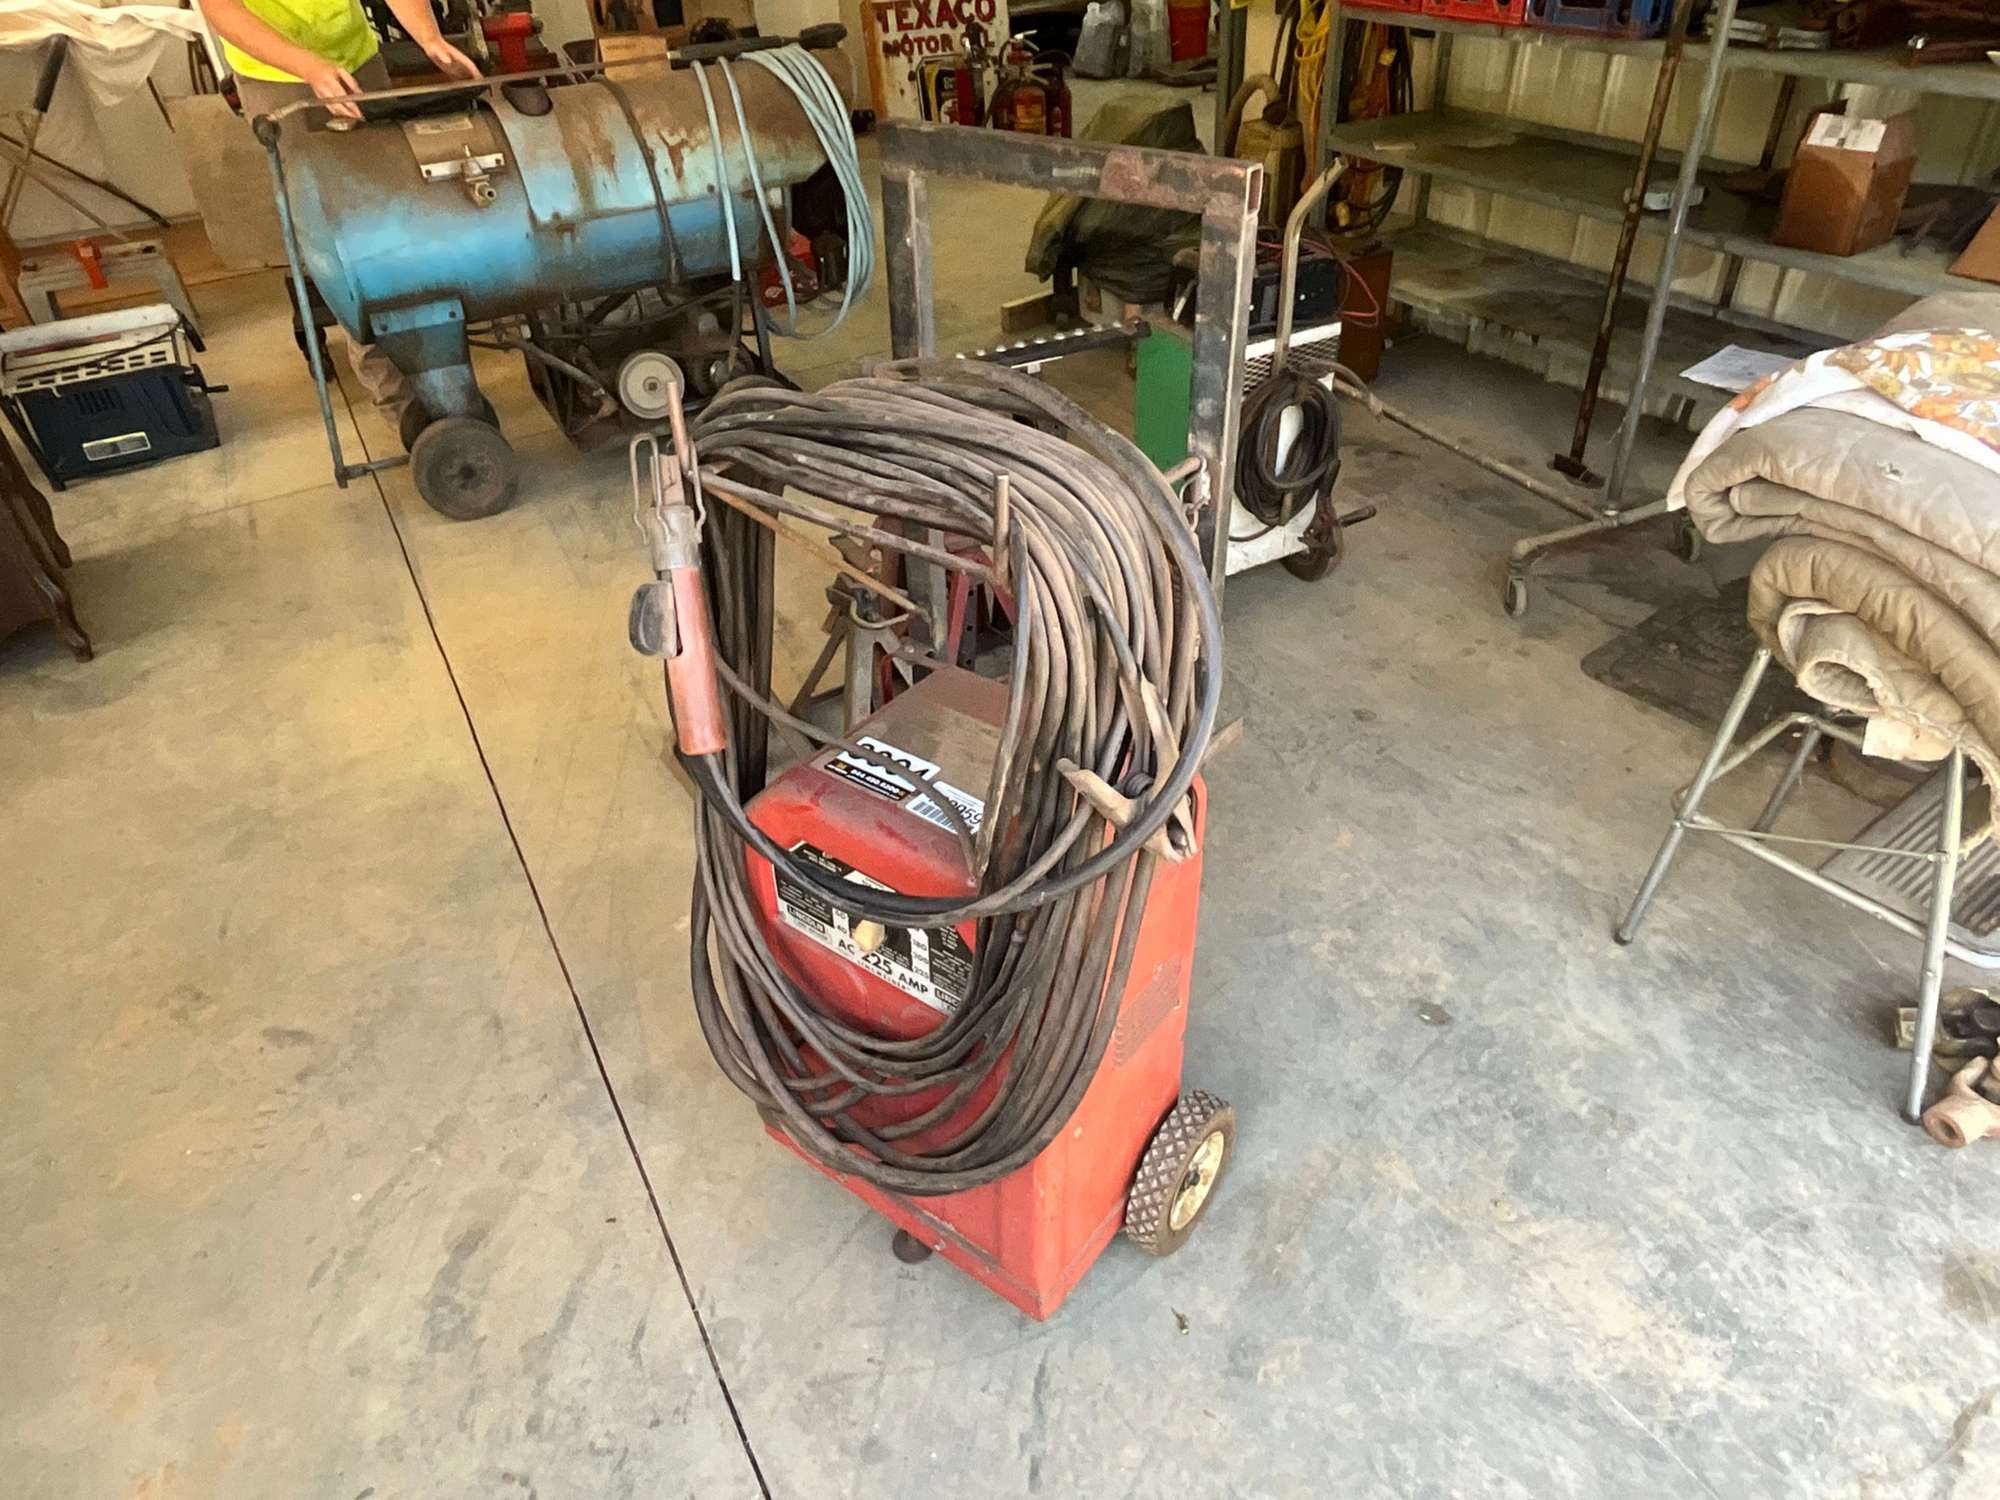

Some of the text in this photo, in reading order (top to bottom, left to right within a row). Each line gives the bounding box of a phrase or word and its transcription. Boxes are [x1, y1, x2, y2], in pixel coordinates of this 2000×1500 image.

[876, 0, 996, 33] TEXACO
[882, 33, 954, 57] MOTOR
[838, 939, 856, 956] AC
[899, 972, 929, 996] AMP
